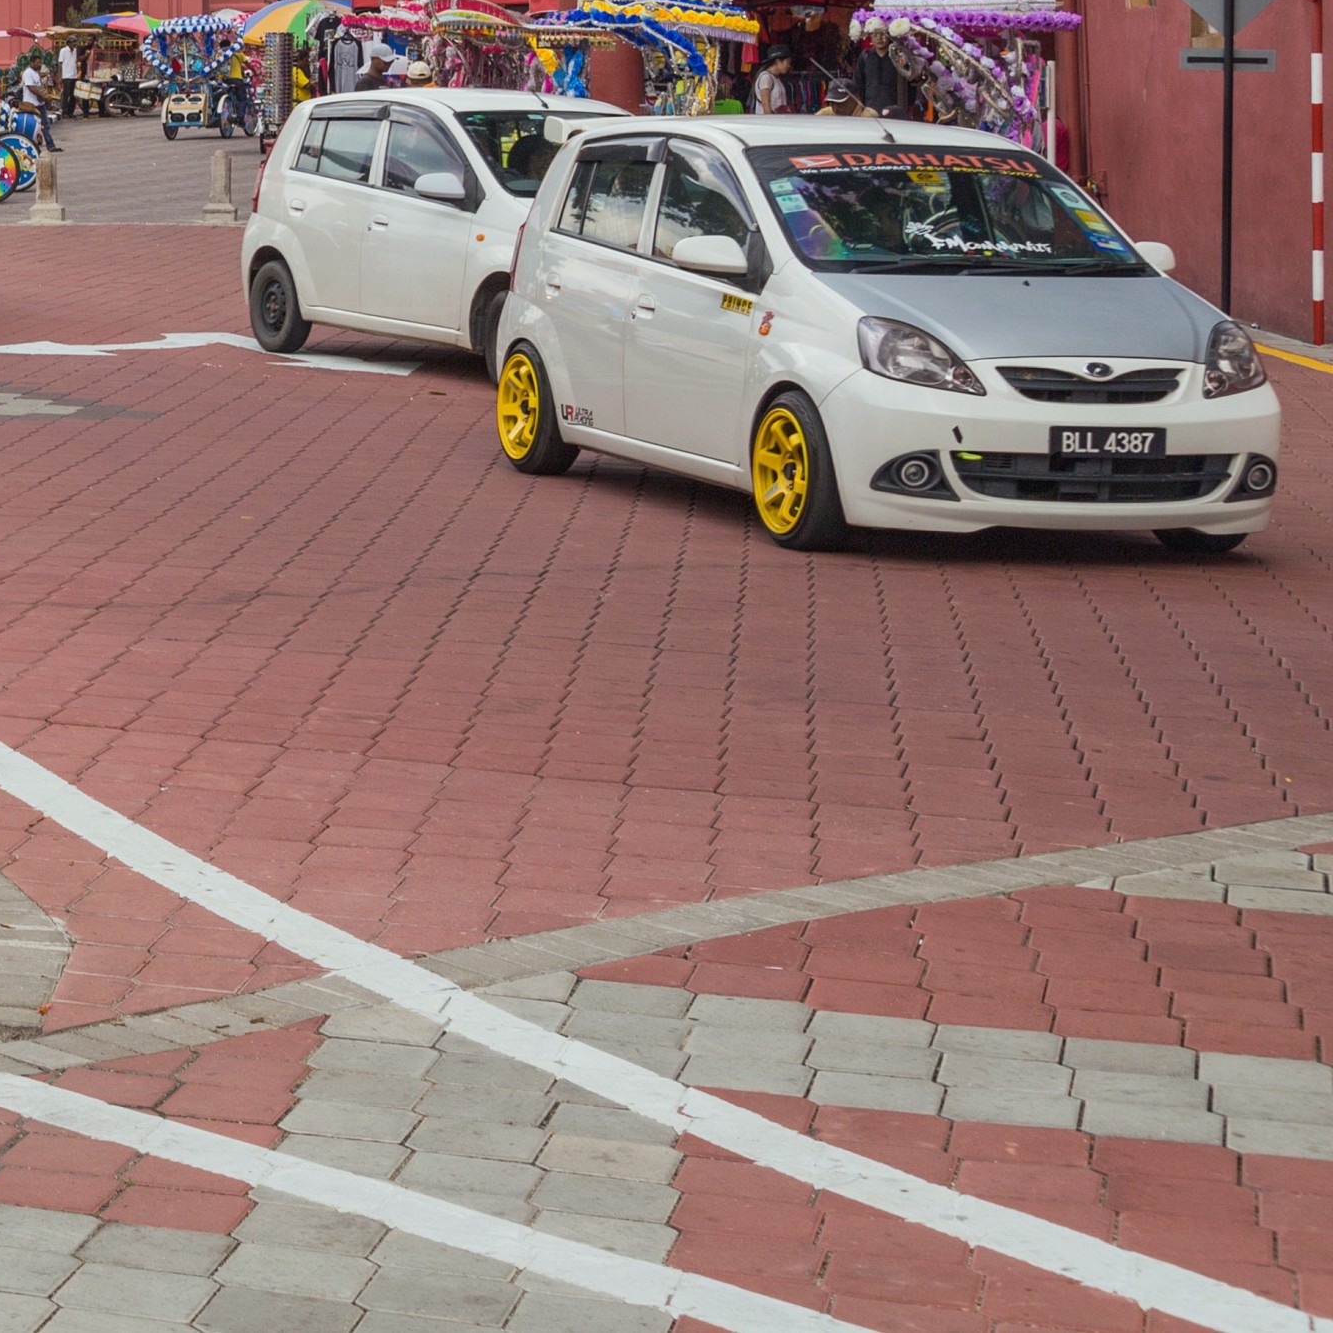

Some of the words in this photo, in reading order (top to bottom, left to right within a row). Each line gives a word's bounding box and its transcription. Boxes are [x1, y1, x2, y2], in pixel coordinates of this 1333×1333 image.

[842, 153, 1038, 173] DAIHATSU
[1062, 432, 1100, 453] BLL
[1103, 432, 1156, 453] 4387
